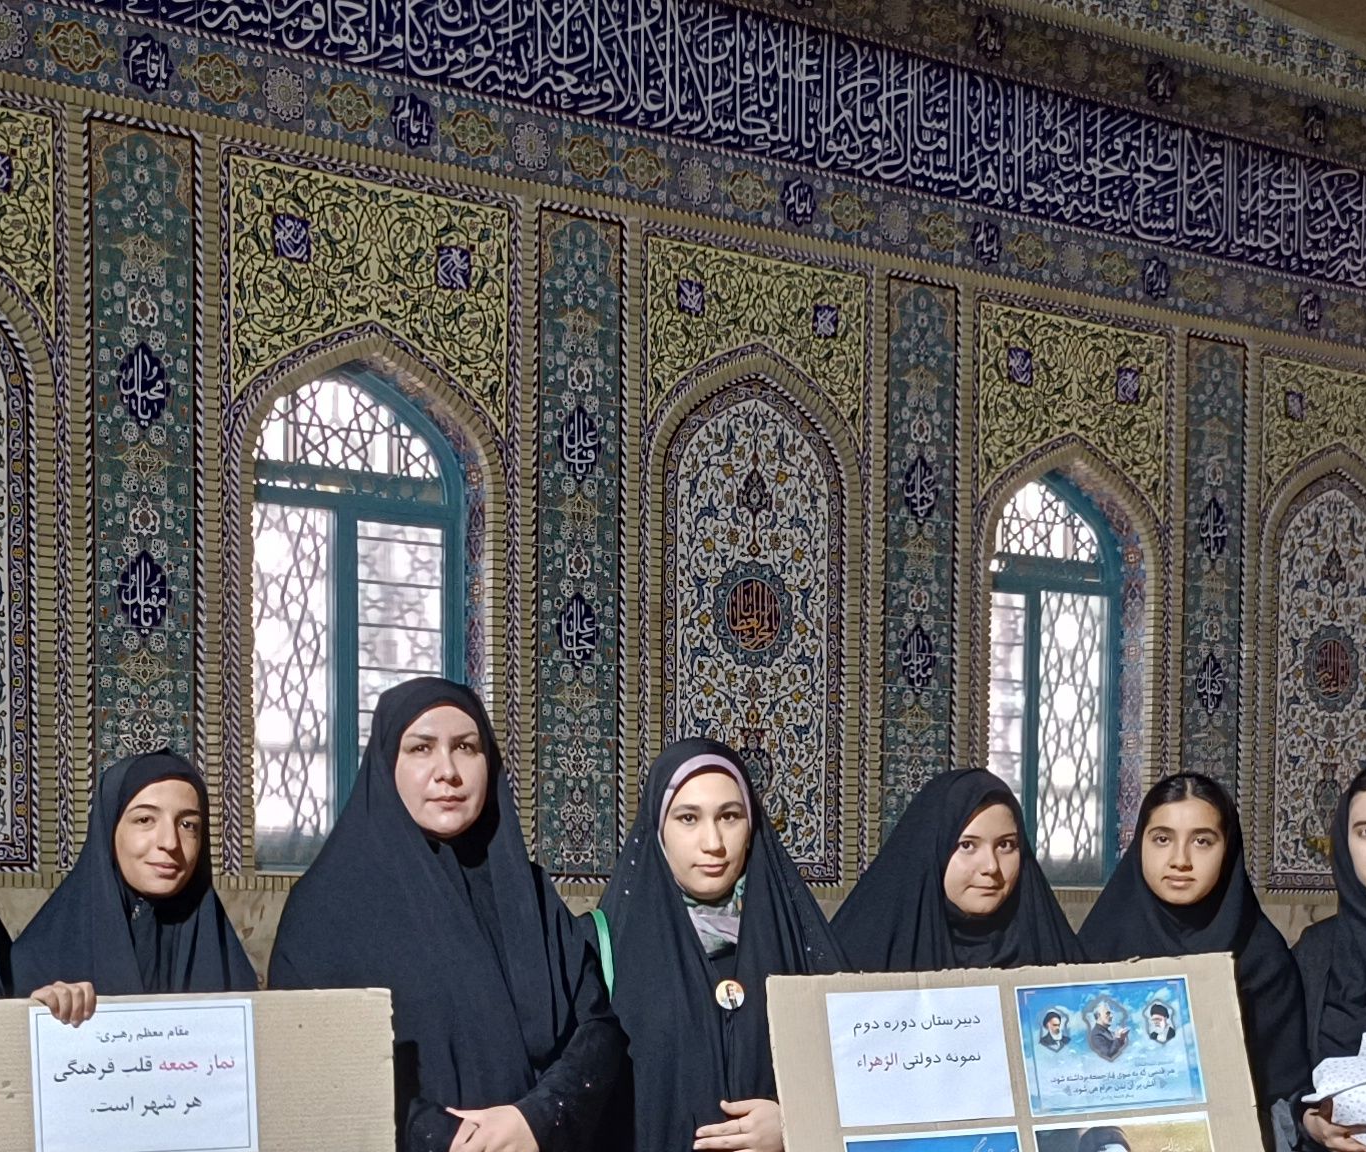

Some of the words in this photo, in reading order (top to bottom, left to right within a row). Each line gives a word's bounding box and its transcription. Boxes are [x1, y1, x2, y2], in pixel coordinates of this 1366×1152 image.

[853, 1020, 880, 1037] دوم
[883, 1018, 916, 1032] دوره
[921, 1014, 981, 1030] دبیرستان
[136, 1027, 163, 1041] معظم
[168, 1025, 189, 1038] مقام
[121, 1055, 153, 1077] قلب
[159, 1059, 198, 1072] جمعه
[207, 1054, 235, 1076] نماز
[857, 1052, 898, 1072] الزهراء
[902, 1052, 941, 1070] دولتی
[945, 1051, 981, 1067] نمونه
[54, 1057, 115, 1082] فرهنگی
[141, 1094, 176, 1117] شهر
[183, 1096, 202, 1115] هر
